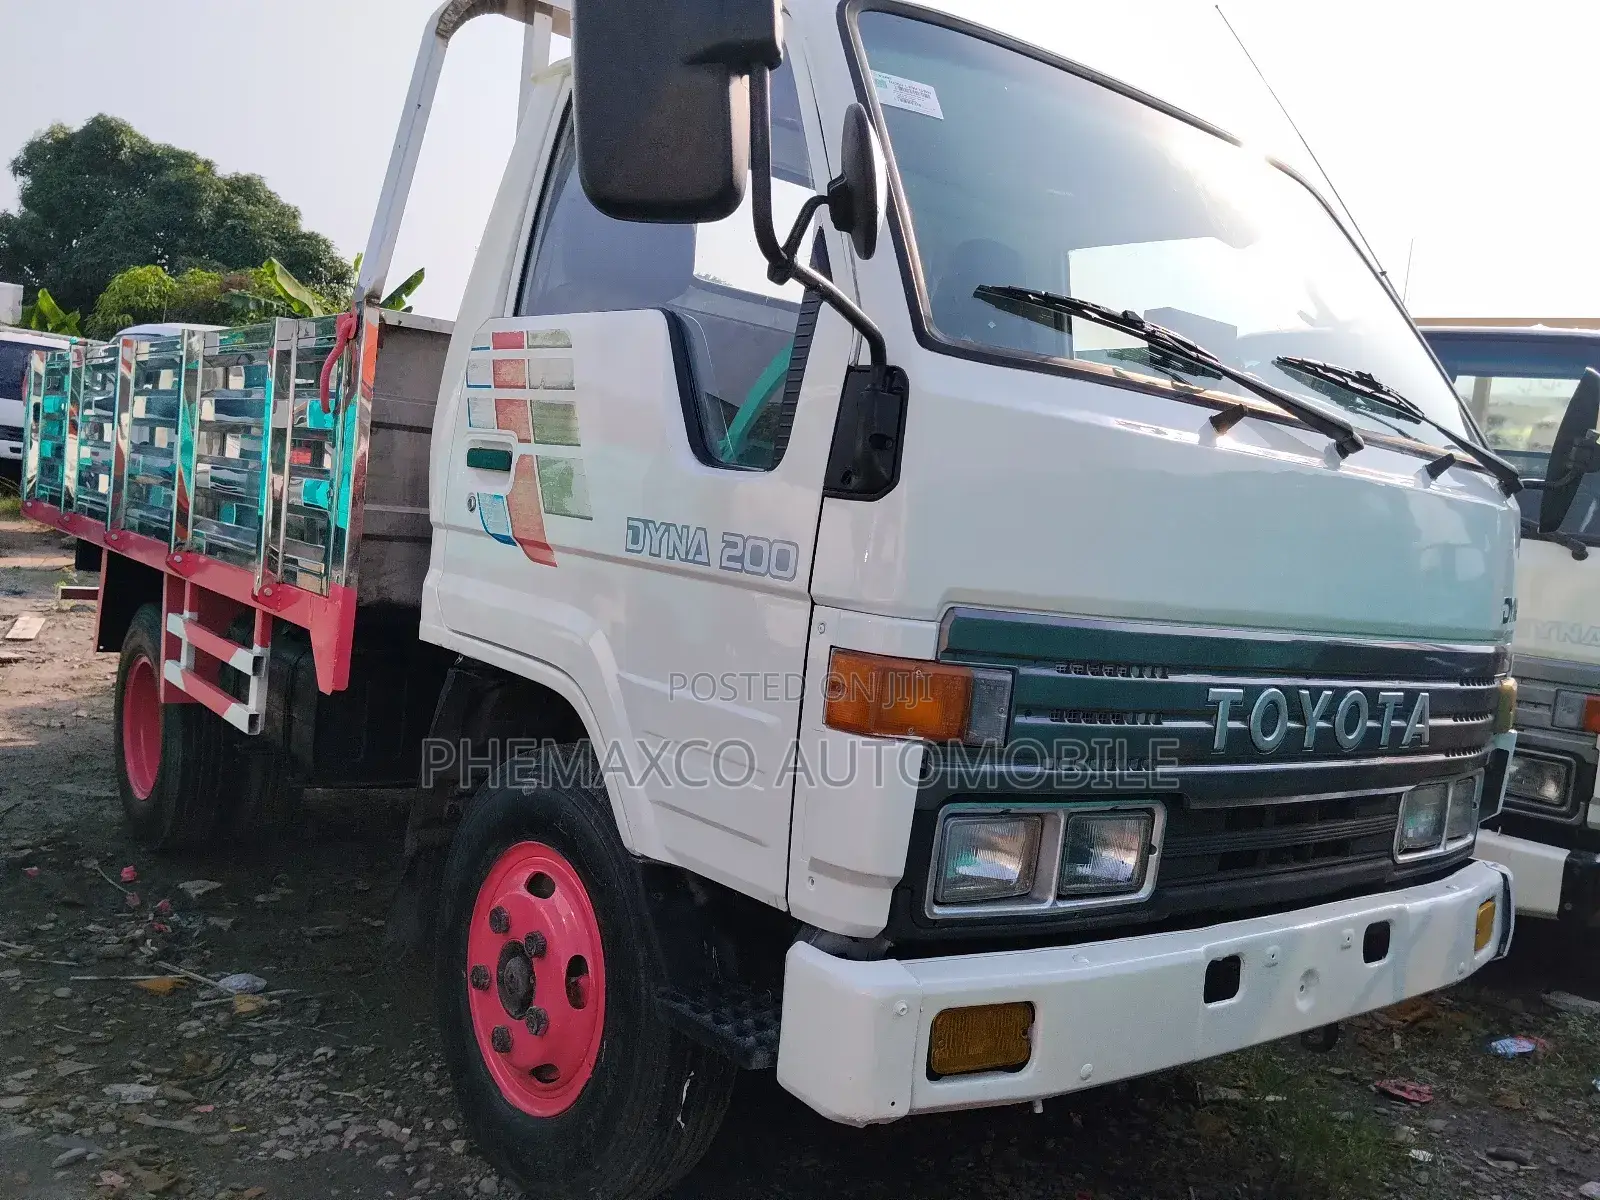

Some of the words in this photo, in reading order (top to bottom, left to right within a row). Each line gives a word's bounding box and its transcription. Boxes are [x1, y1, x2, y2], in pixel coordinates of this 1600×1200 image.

[625, 517, 711, 567] DYNA
[719, 532, 800, 582] 200
[1206, 687, 1430, 754] TOYOTA
